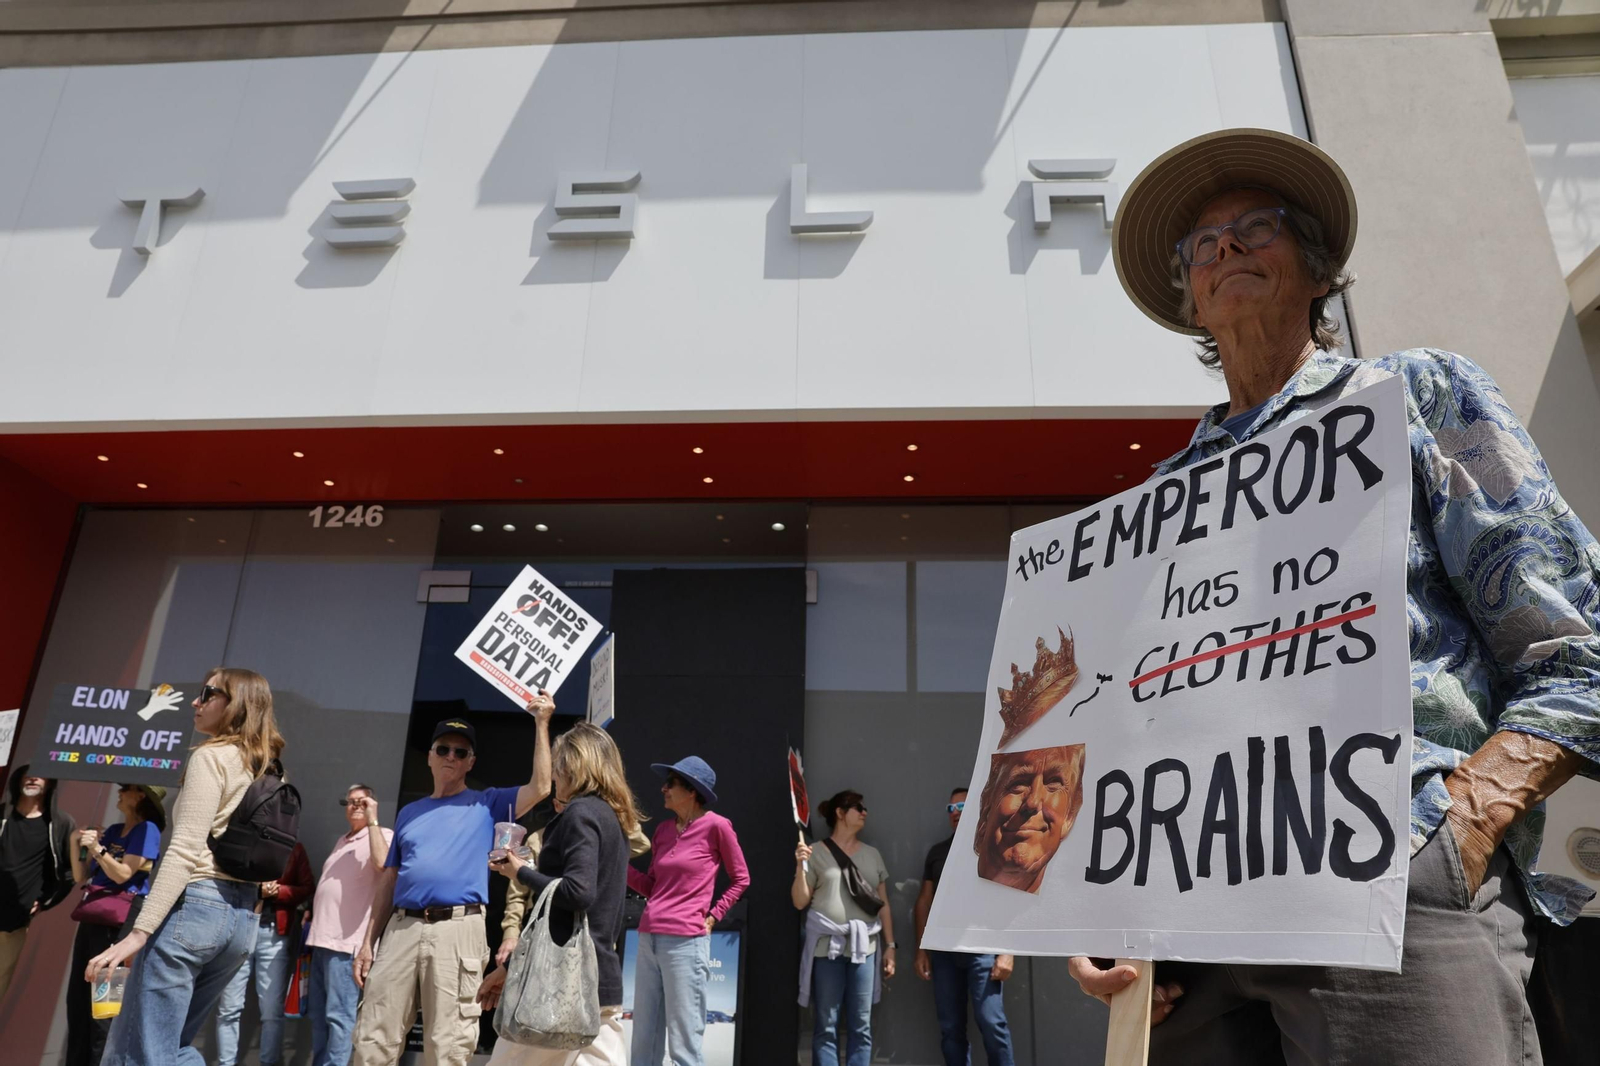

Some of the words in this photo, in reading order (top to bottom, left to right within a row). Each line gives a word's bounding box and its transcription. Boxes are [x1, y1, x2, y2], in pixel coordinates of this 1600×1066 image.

[116, 158, 1119, 256] TESLA
[308, 505, 384, 528] 1246
[1015, 534, 1065, 582] the
[1067, 404, 1384, 583] EMPEROR
[528, 578, 589, 632] HANDS
[1160, 562, 1240, 620] has
[1272, 546, 1340, 594] no
[494, 611, 564, 674] PERSONAL
[514, 593, 580, 651] OFF!
[1131, 591, 1377, 703] CLOTHES
[475, 625, 552, 696] DATA
[71, 686, 130, 710] ELON
[49, 751, 80, 763] THE
[85, 753, 182, 770] GOVERNMENT
[55, 723, 129, 748] HANDS
[140, 729, 183, 752] OFF
[1084, 725, 1402, 893] BRAINS
